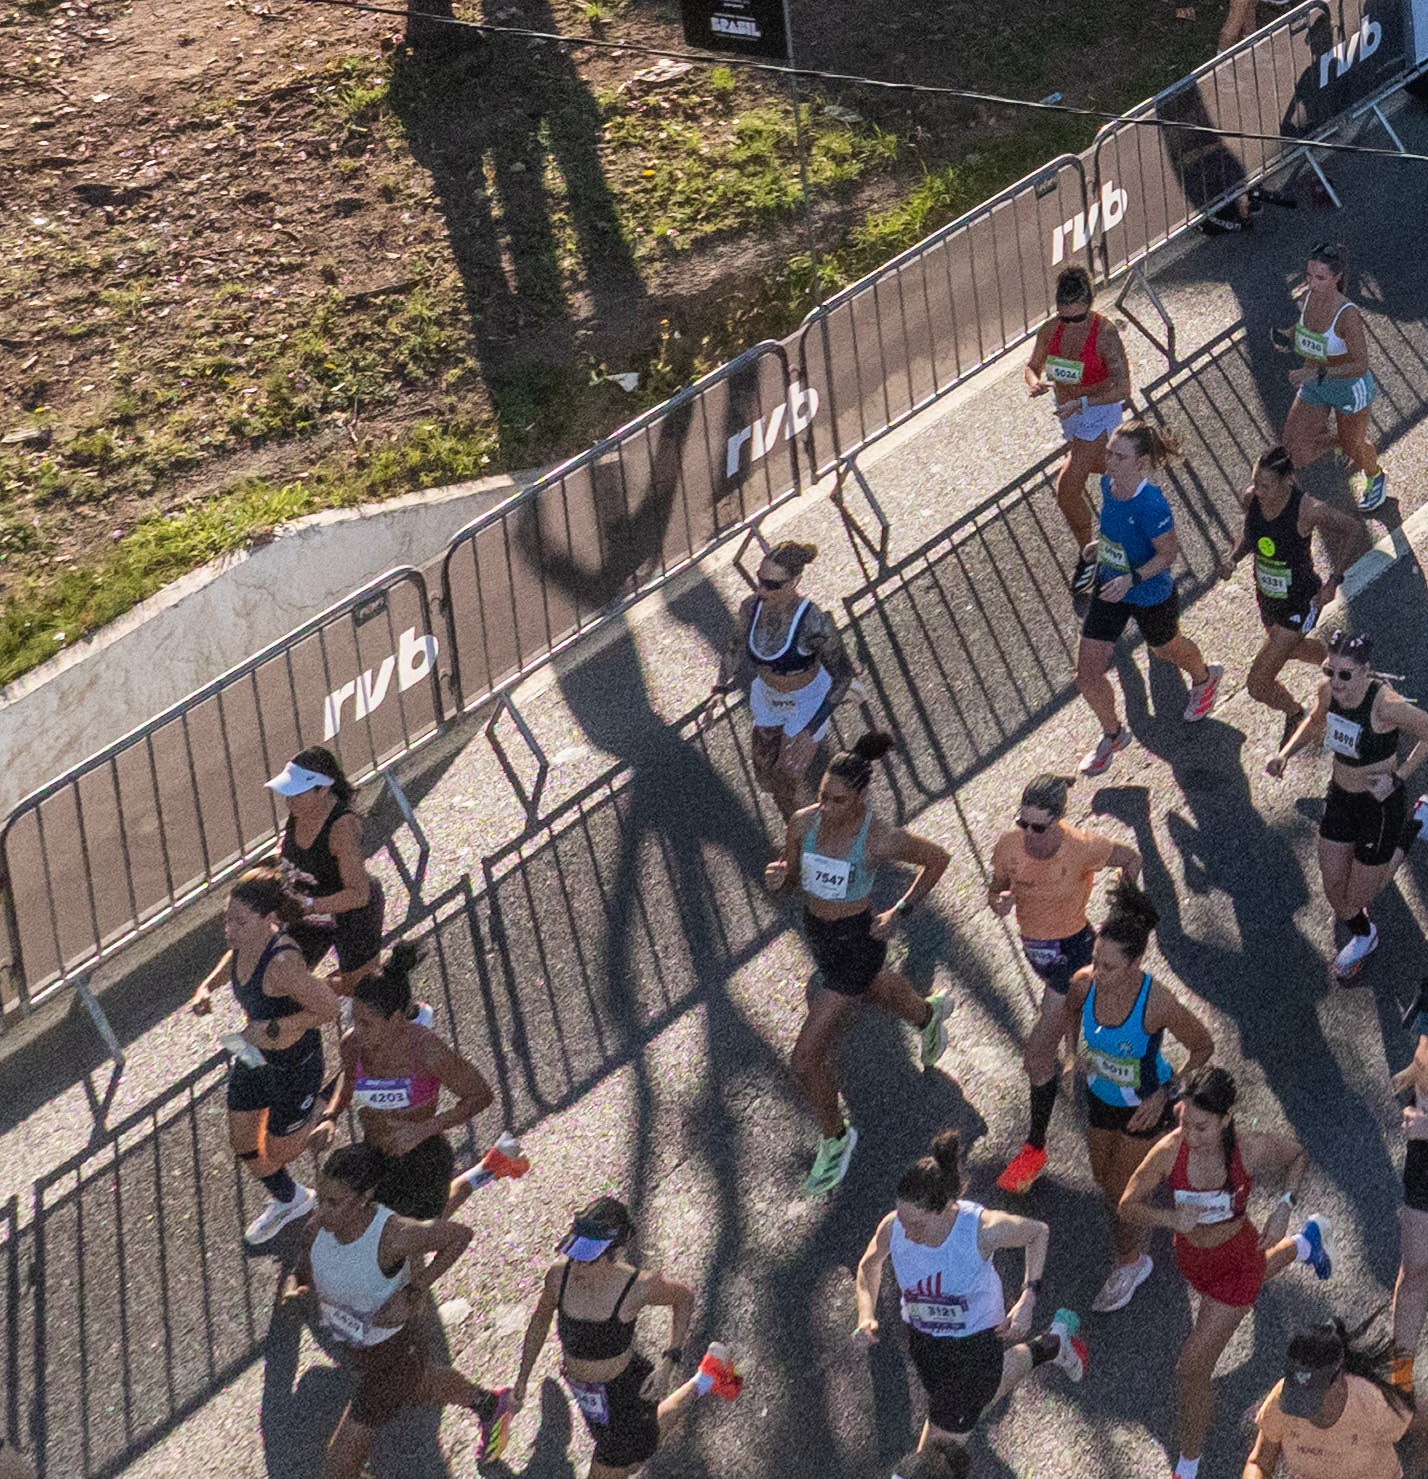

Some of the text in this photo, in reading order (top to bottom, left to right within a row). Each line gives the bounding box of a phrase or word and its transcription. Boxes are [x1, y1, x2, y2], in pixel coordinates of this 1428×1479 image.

[710, 17, 762, 38] BRASIL
[1319, 15, 1383, 89] rvb
[1051, 179, 1129, 266] rvb
[726, 379, 820, 478] rvb
[323, 626, 440, 741] rvb
[814, 870, 845, 886] 7547
[368, 1092, 405, 1105] 4203
